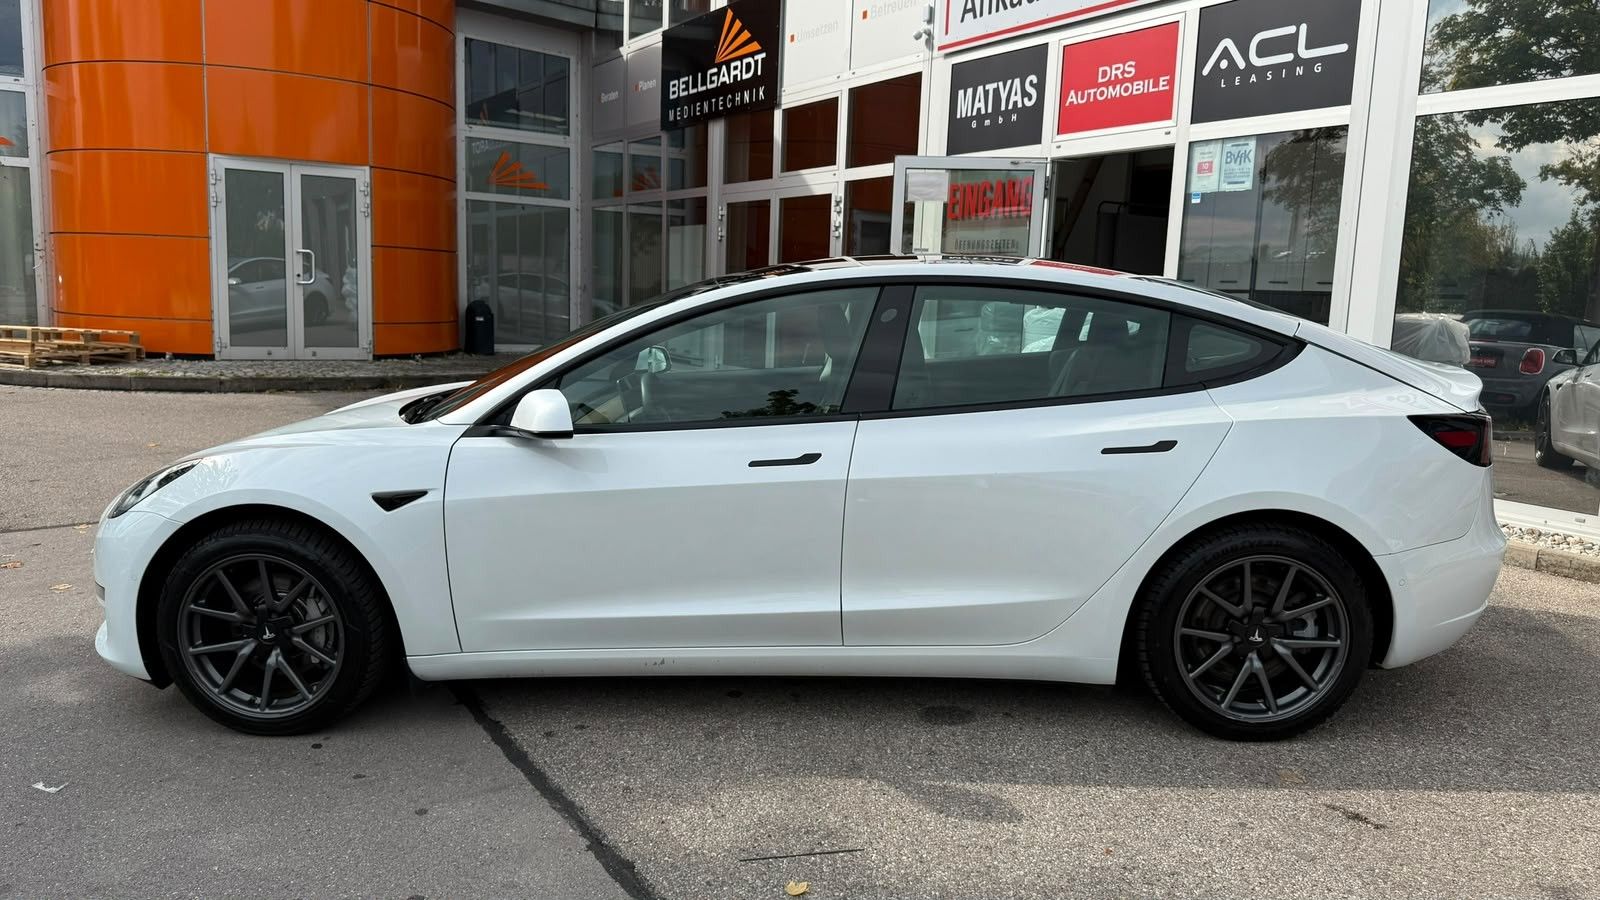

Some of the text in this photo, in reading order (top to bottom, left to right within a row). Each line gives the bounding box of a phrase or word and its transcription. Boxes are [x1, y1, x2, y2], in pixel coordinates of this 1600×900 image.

[1202, 22, 1349, 76] ACL
[669, 52, 767, 100] BELLGARDT
[1097, 60, 1136, 83] DRS
[1220, 62, 1322, 88] LEASING
[668, 85, 765, 122] MEDIENTECHNIK
[956, 74, 1038, 119] MATYAS
[971, 113, 1017, 128] GmbH
